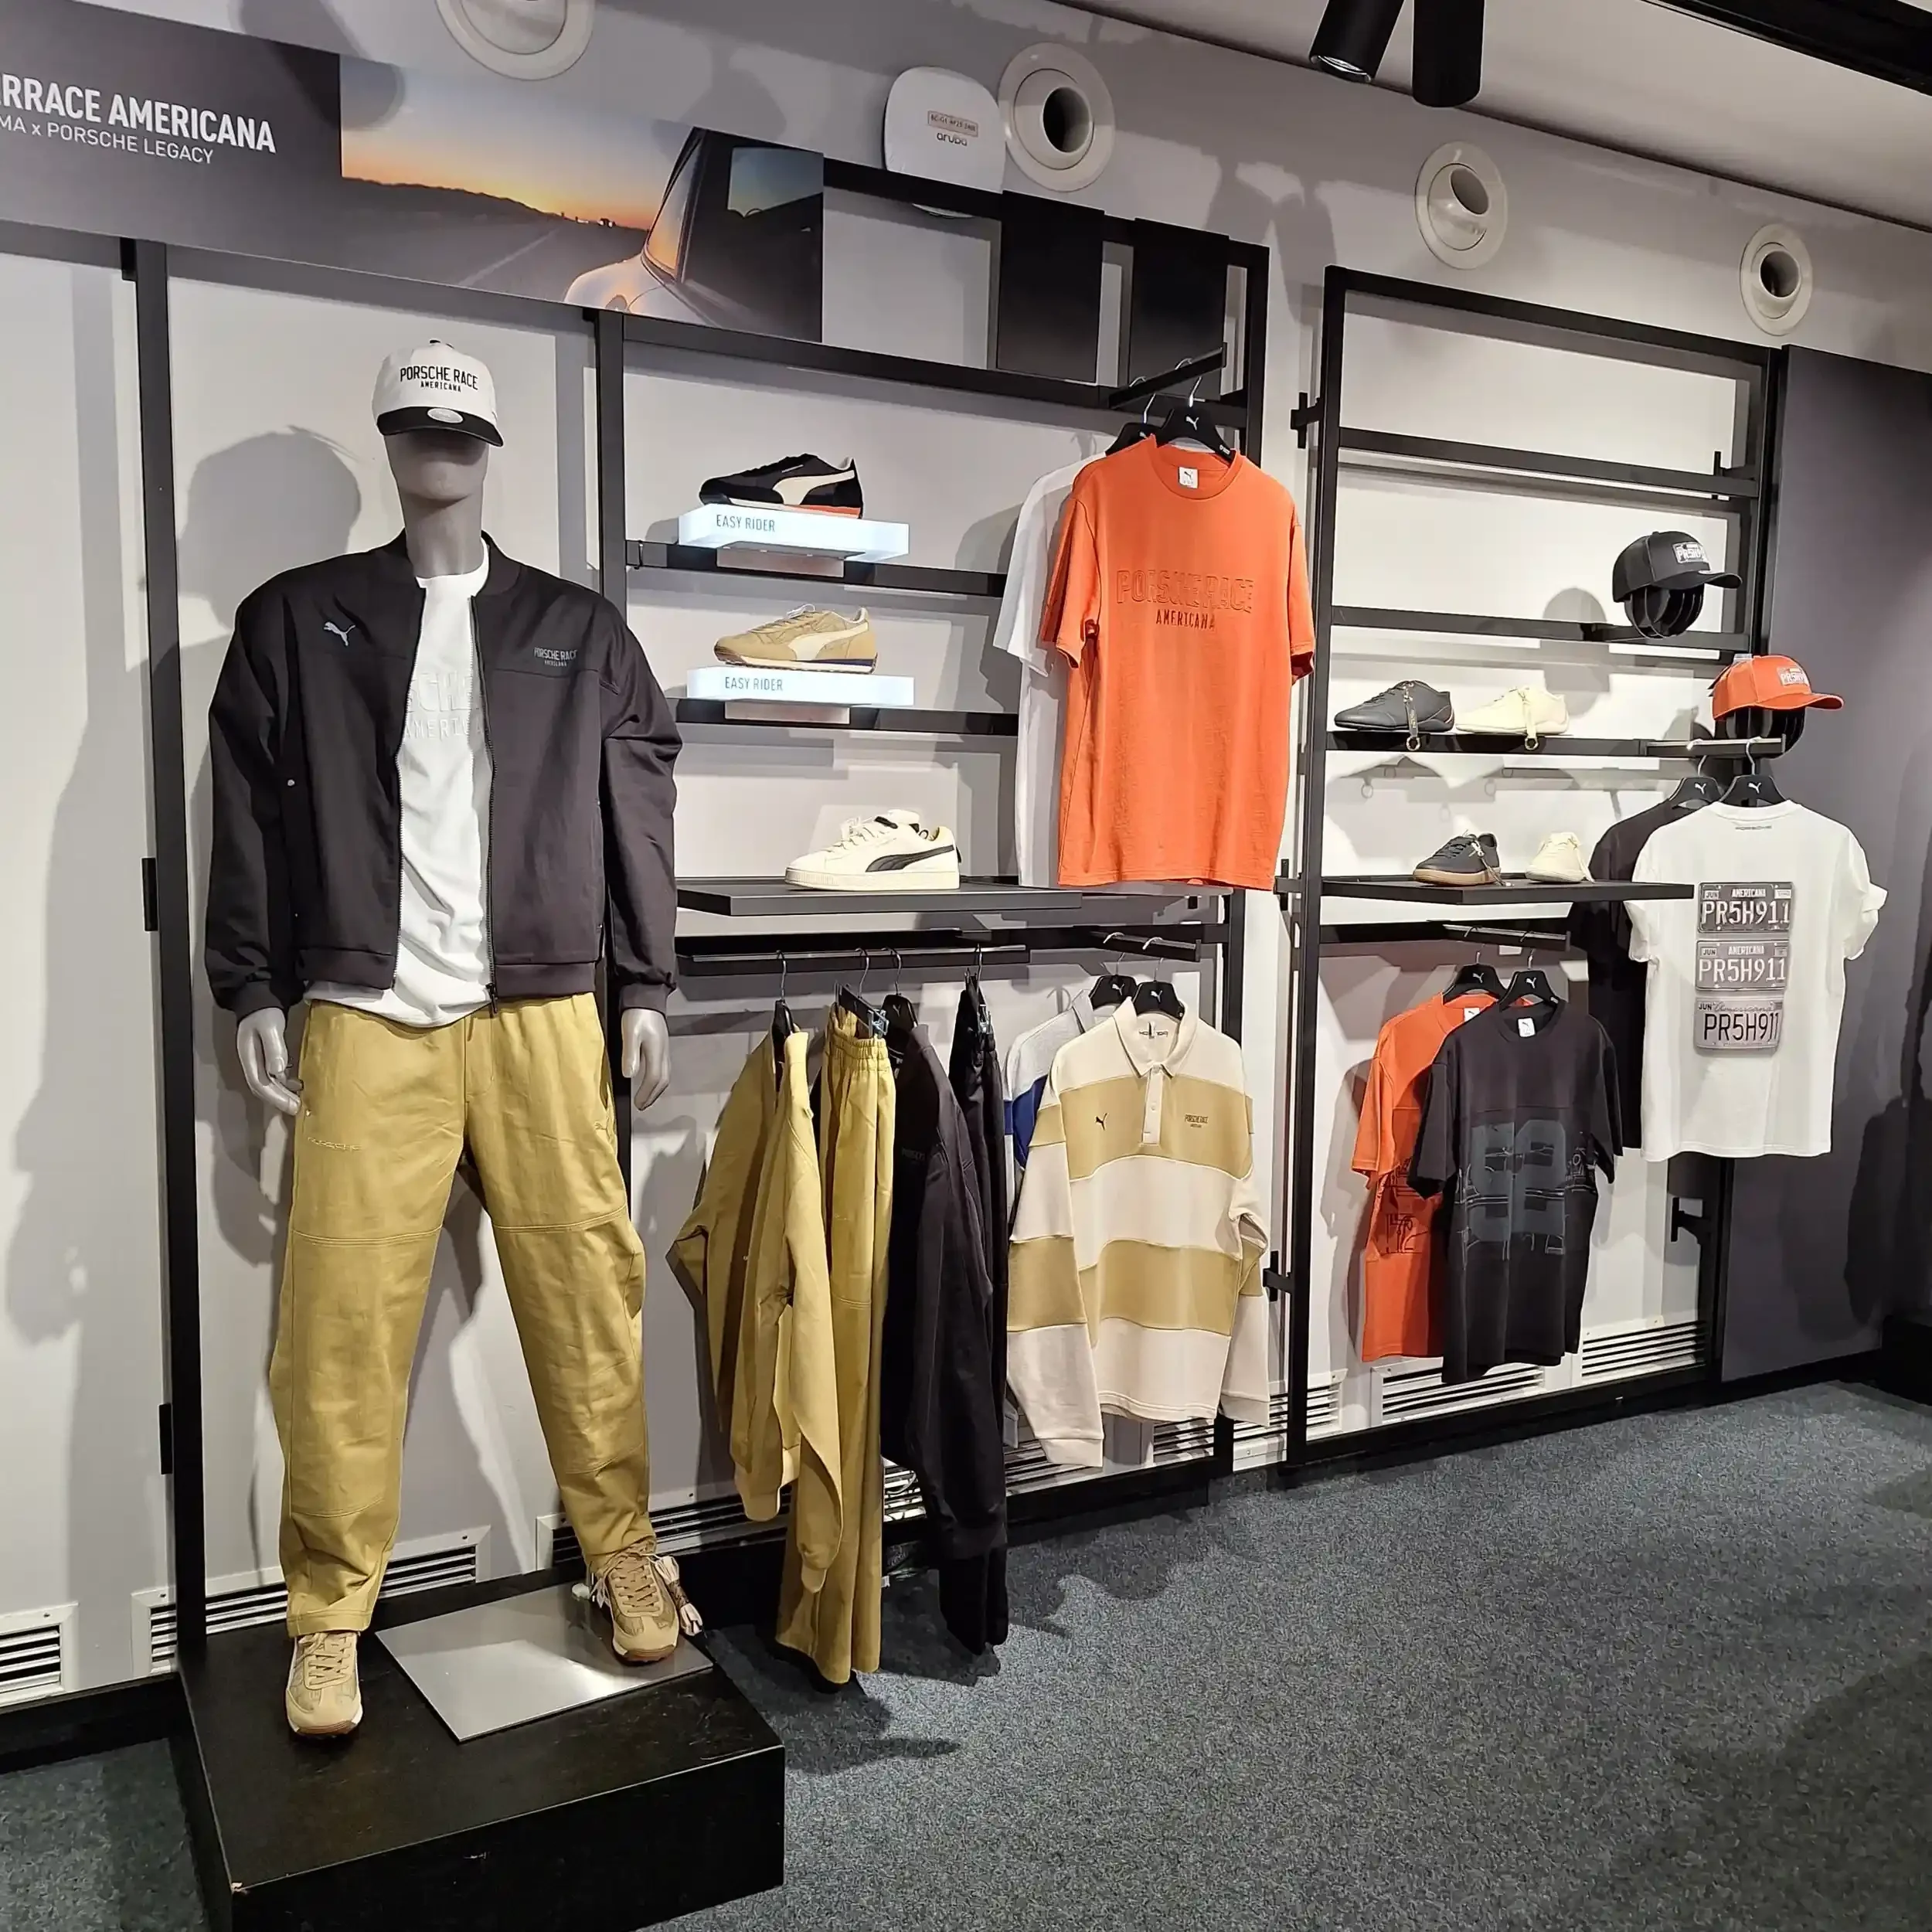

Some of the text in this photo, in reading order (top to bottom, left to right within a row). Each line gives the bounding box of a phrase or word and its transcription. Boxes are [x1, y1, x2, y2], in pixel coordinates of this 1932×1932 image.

[0, 73, 277, 154] RRACE AMERICANA
[32, 124, 42, 136] x
[47, 121, 138, 152] PORSCHE
[144, 138, 213, 164] LEGACY
[400, 366, 478, 390] PORSCHE RACE
[420, 380, 461, 393] AMERICANA
[716, 514, 775, 532] EASY RIDER
[1155, 608, 1216, 630] AMERICANA
[725, 676, 783, 691] EASY RIDER
[1732, 888, 1766, 898] AMERICANA
[1701, 900, 1790, 924] PR5H911
[1728, 946, 1764, 955] AMERICANA
[1699, 957, 1786, 982] PR5H911
[1704, 1012, 1778, 1042] PR5H911
